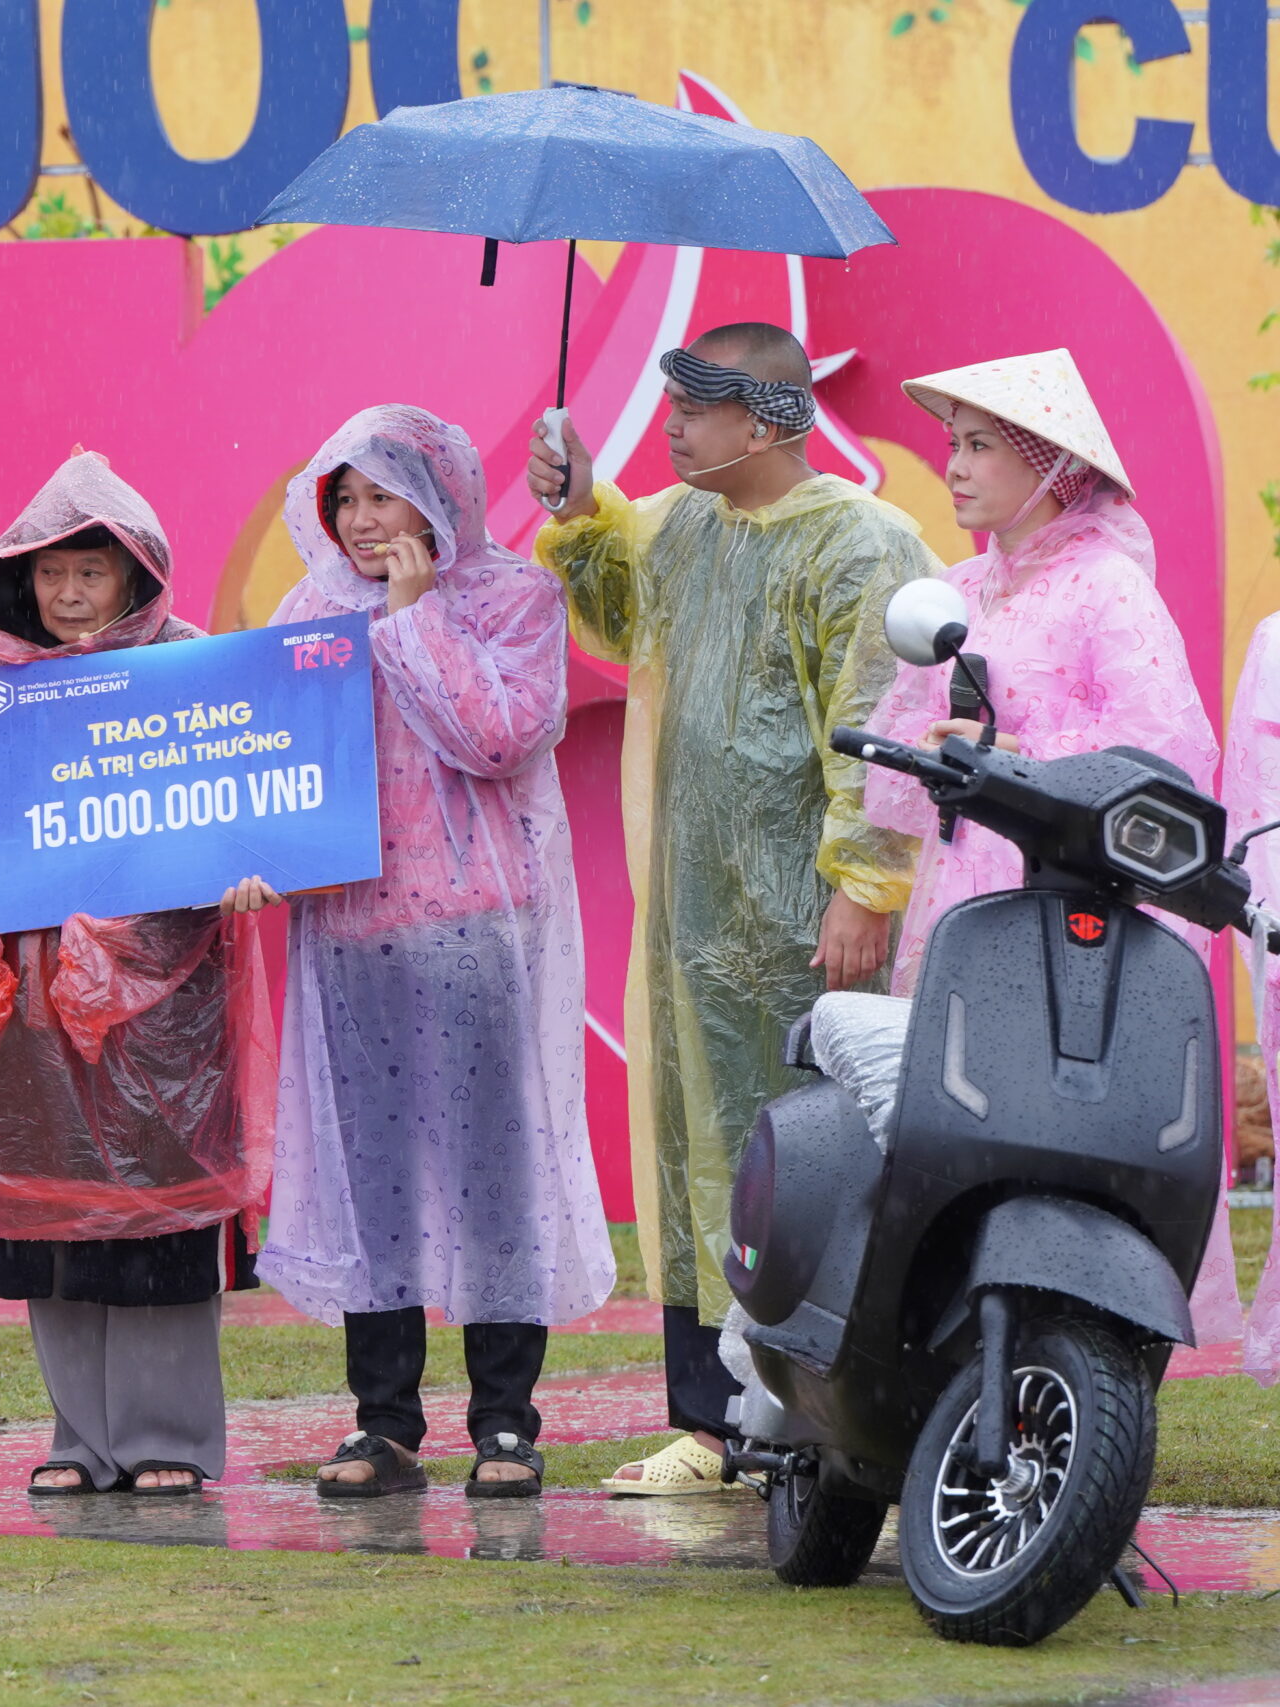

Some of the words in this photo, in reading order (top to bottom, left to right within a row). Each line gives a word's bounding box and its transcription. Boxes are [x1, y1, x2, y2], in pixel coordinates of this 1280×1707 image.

[18, 689, 62, 705] SEOUL
[65, 679, 130, 698] ACADEMY
[87, 714, 168, 746] TRAO
[173, 701, 254, 738] TẶNG
[51, 755, 95, 783] GIÁ
[98, 753, 134, 778] TRỊ
[139, 742, 188, 771] GIẢI
[192, 730, 293, 762] THƯỞNG
[24, 776, 239, 850] 15.000.000
[246, 763, 324, 818] VNĐ
